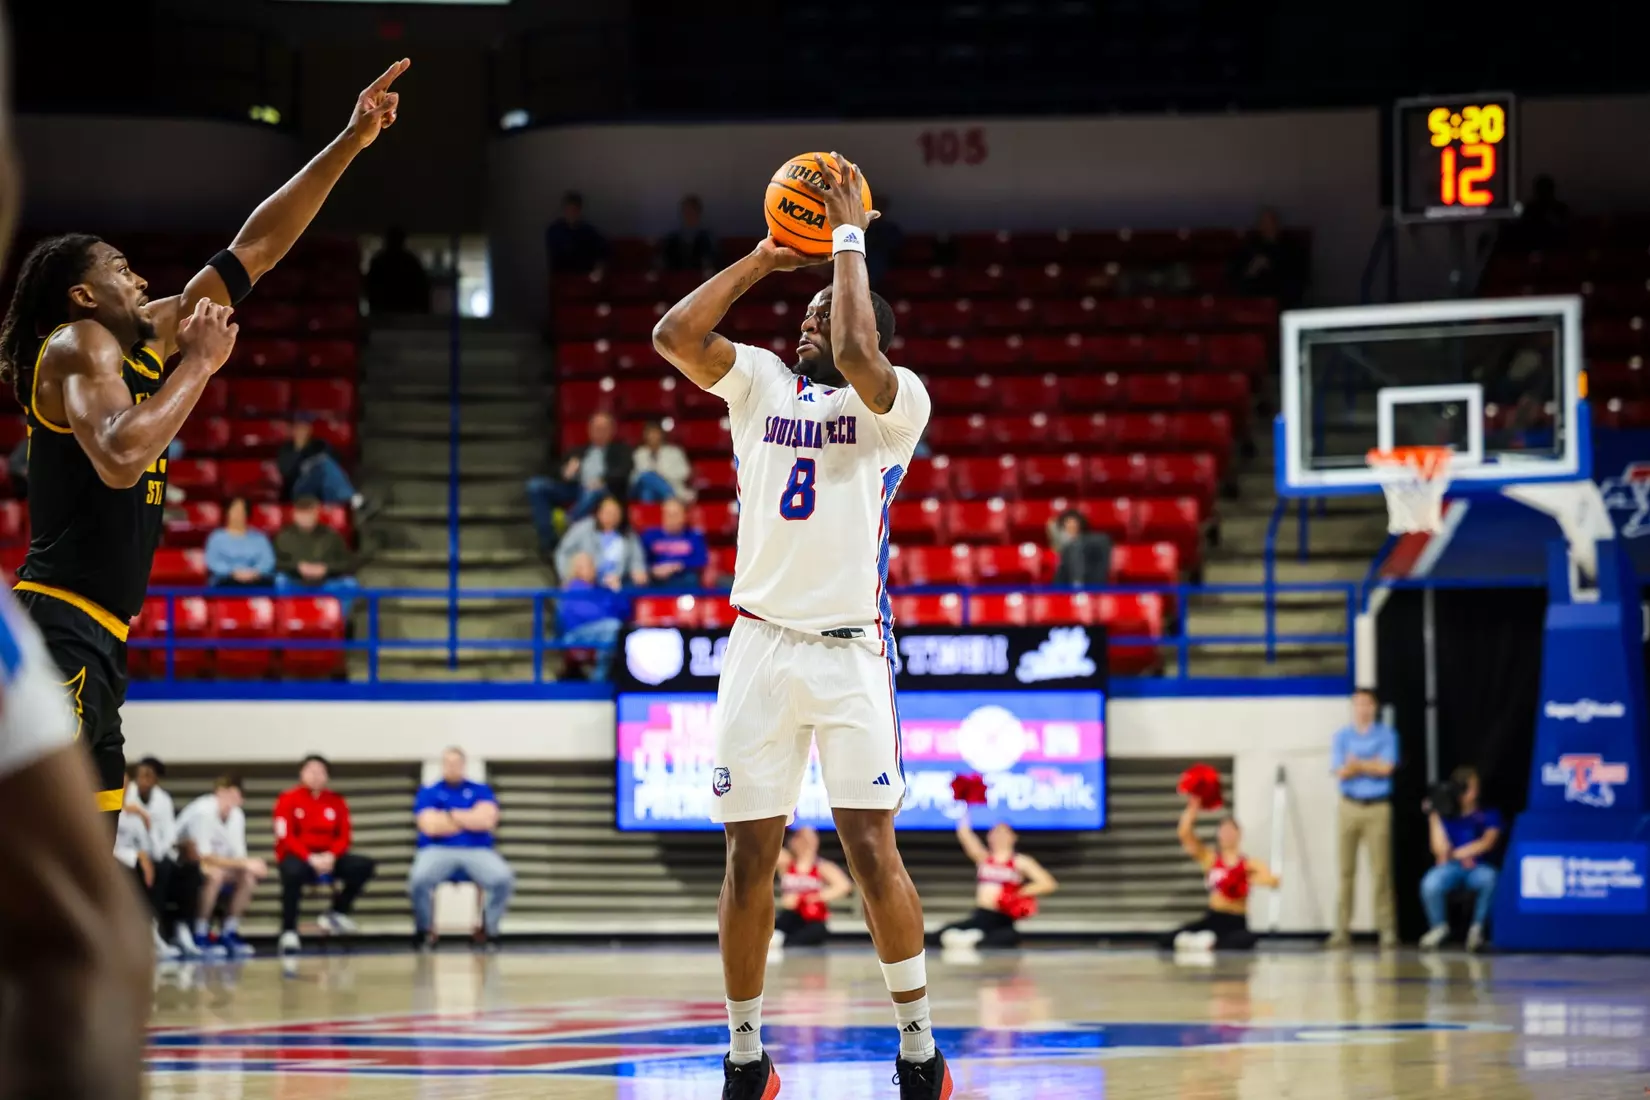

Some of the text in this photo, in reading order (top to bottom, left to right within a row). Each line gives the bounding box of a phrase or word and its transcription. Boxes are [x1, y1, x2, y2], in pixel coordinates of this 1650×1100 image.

[1428, 104, 1505, 147] 5:20
[917, 128, 989, 167] 105
[1441, 143, 1496, 206] 12
[778, 197, 826, 229] NCAA
[780, 457, 816, 520] 8
